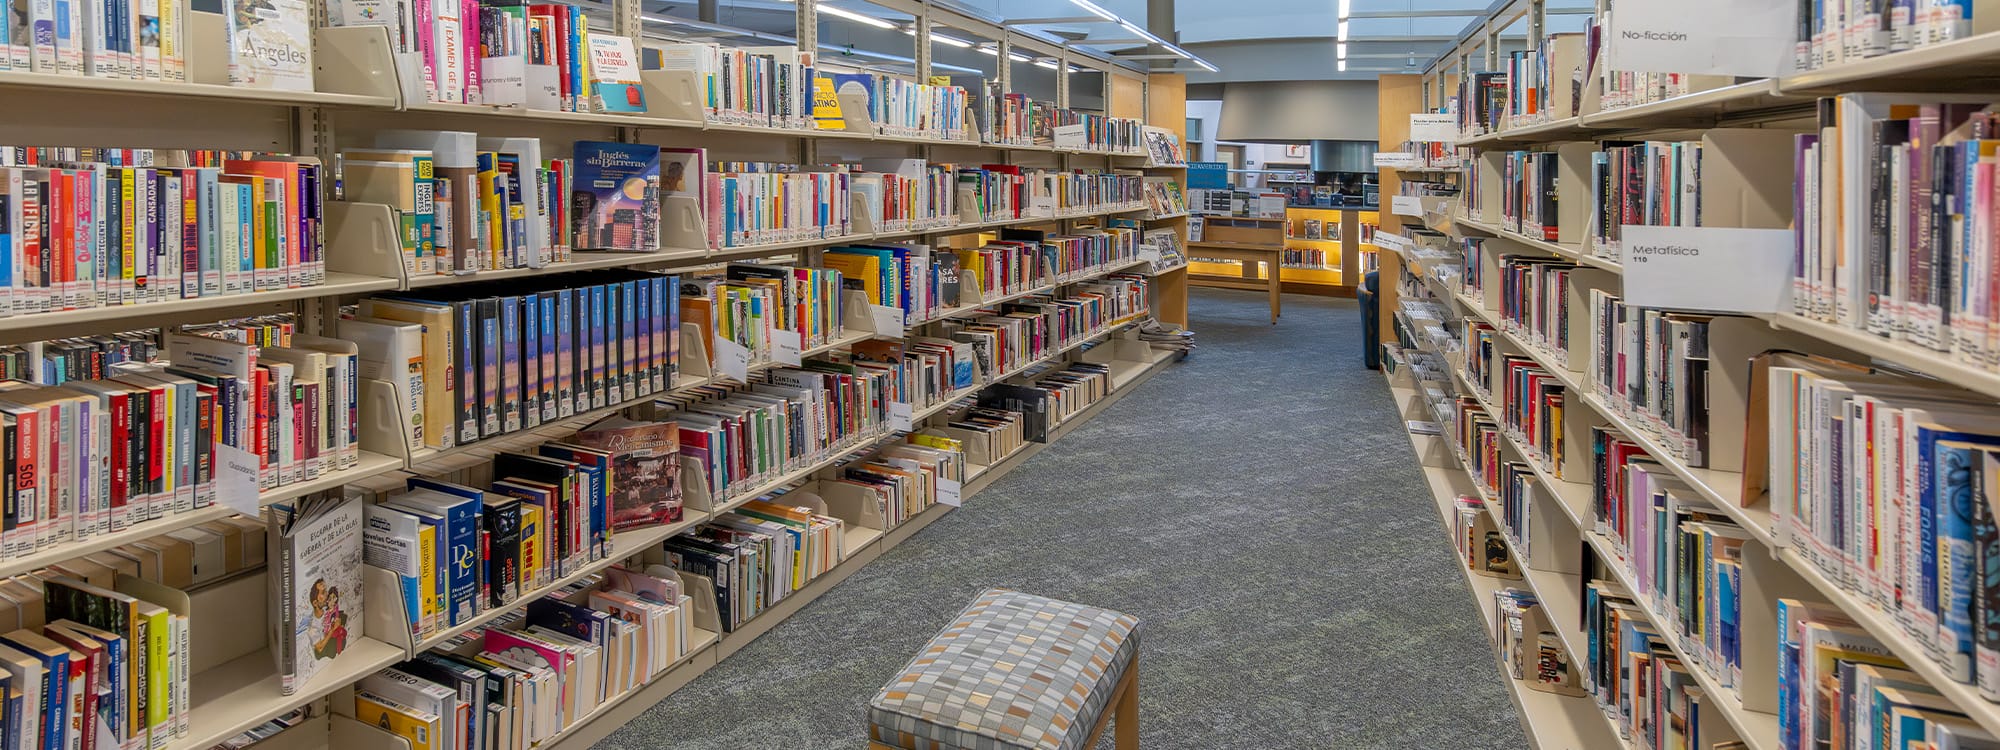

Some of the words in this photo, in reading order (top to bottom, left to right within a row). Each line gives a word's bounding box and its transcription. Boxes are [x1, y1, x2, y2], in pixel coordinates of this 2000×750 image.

[1622, 29, 1687, 42] No-ficción
[446, 29, 456, 68] EXAMEN
[813, 99, 837, 108] ATINO
[598, 149, 630, 161] Inglés
[24, 179, 39, 247] ARTIFICIAL
[147, 179, 157, 224] CANSADAS
[1632, 244, 1700, 257] Metafísica
[20, 463, 34, 488] SOS
[300, 542, 322, 560] GUERRA
[327, 533, 335, 542] DE
[335, 527, 345, 538] LAS
[345, 519, 359, 531] OLAS
[310, 521, 333, 542] ESCAPAR
[333, 516, 341, 528] DE
[341, 513, 348, 524] LA
[1920, 505, 1932, 564] FOCUS
[385, 537, 407, 548] Cortas
[72, 716, 81, 731] HOT
